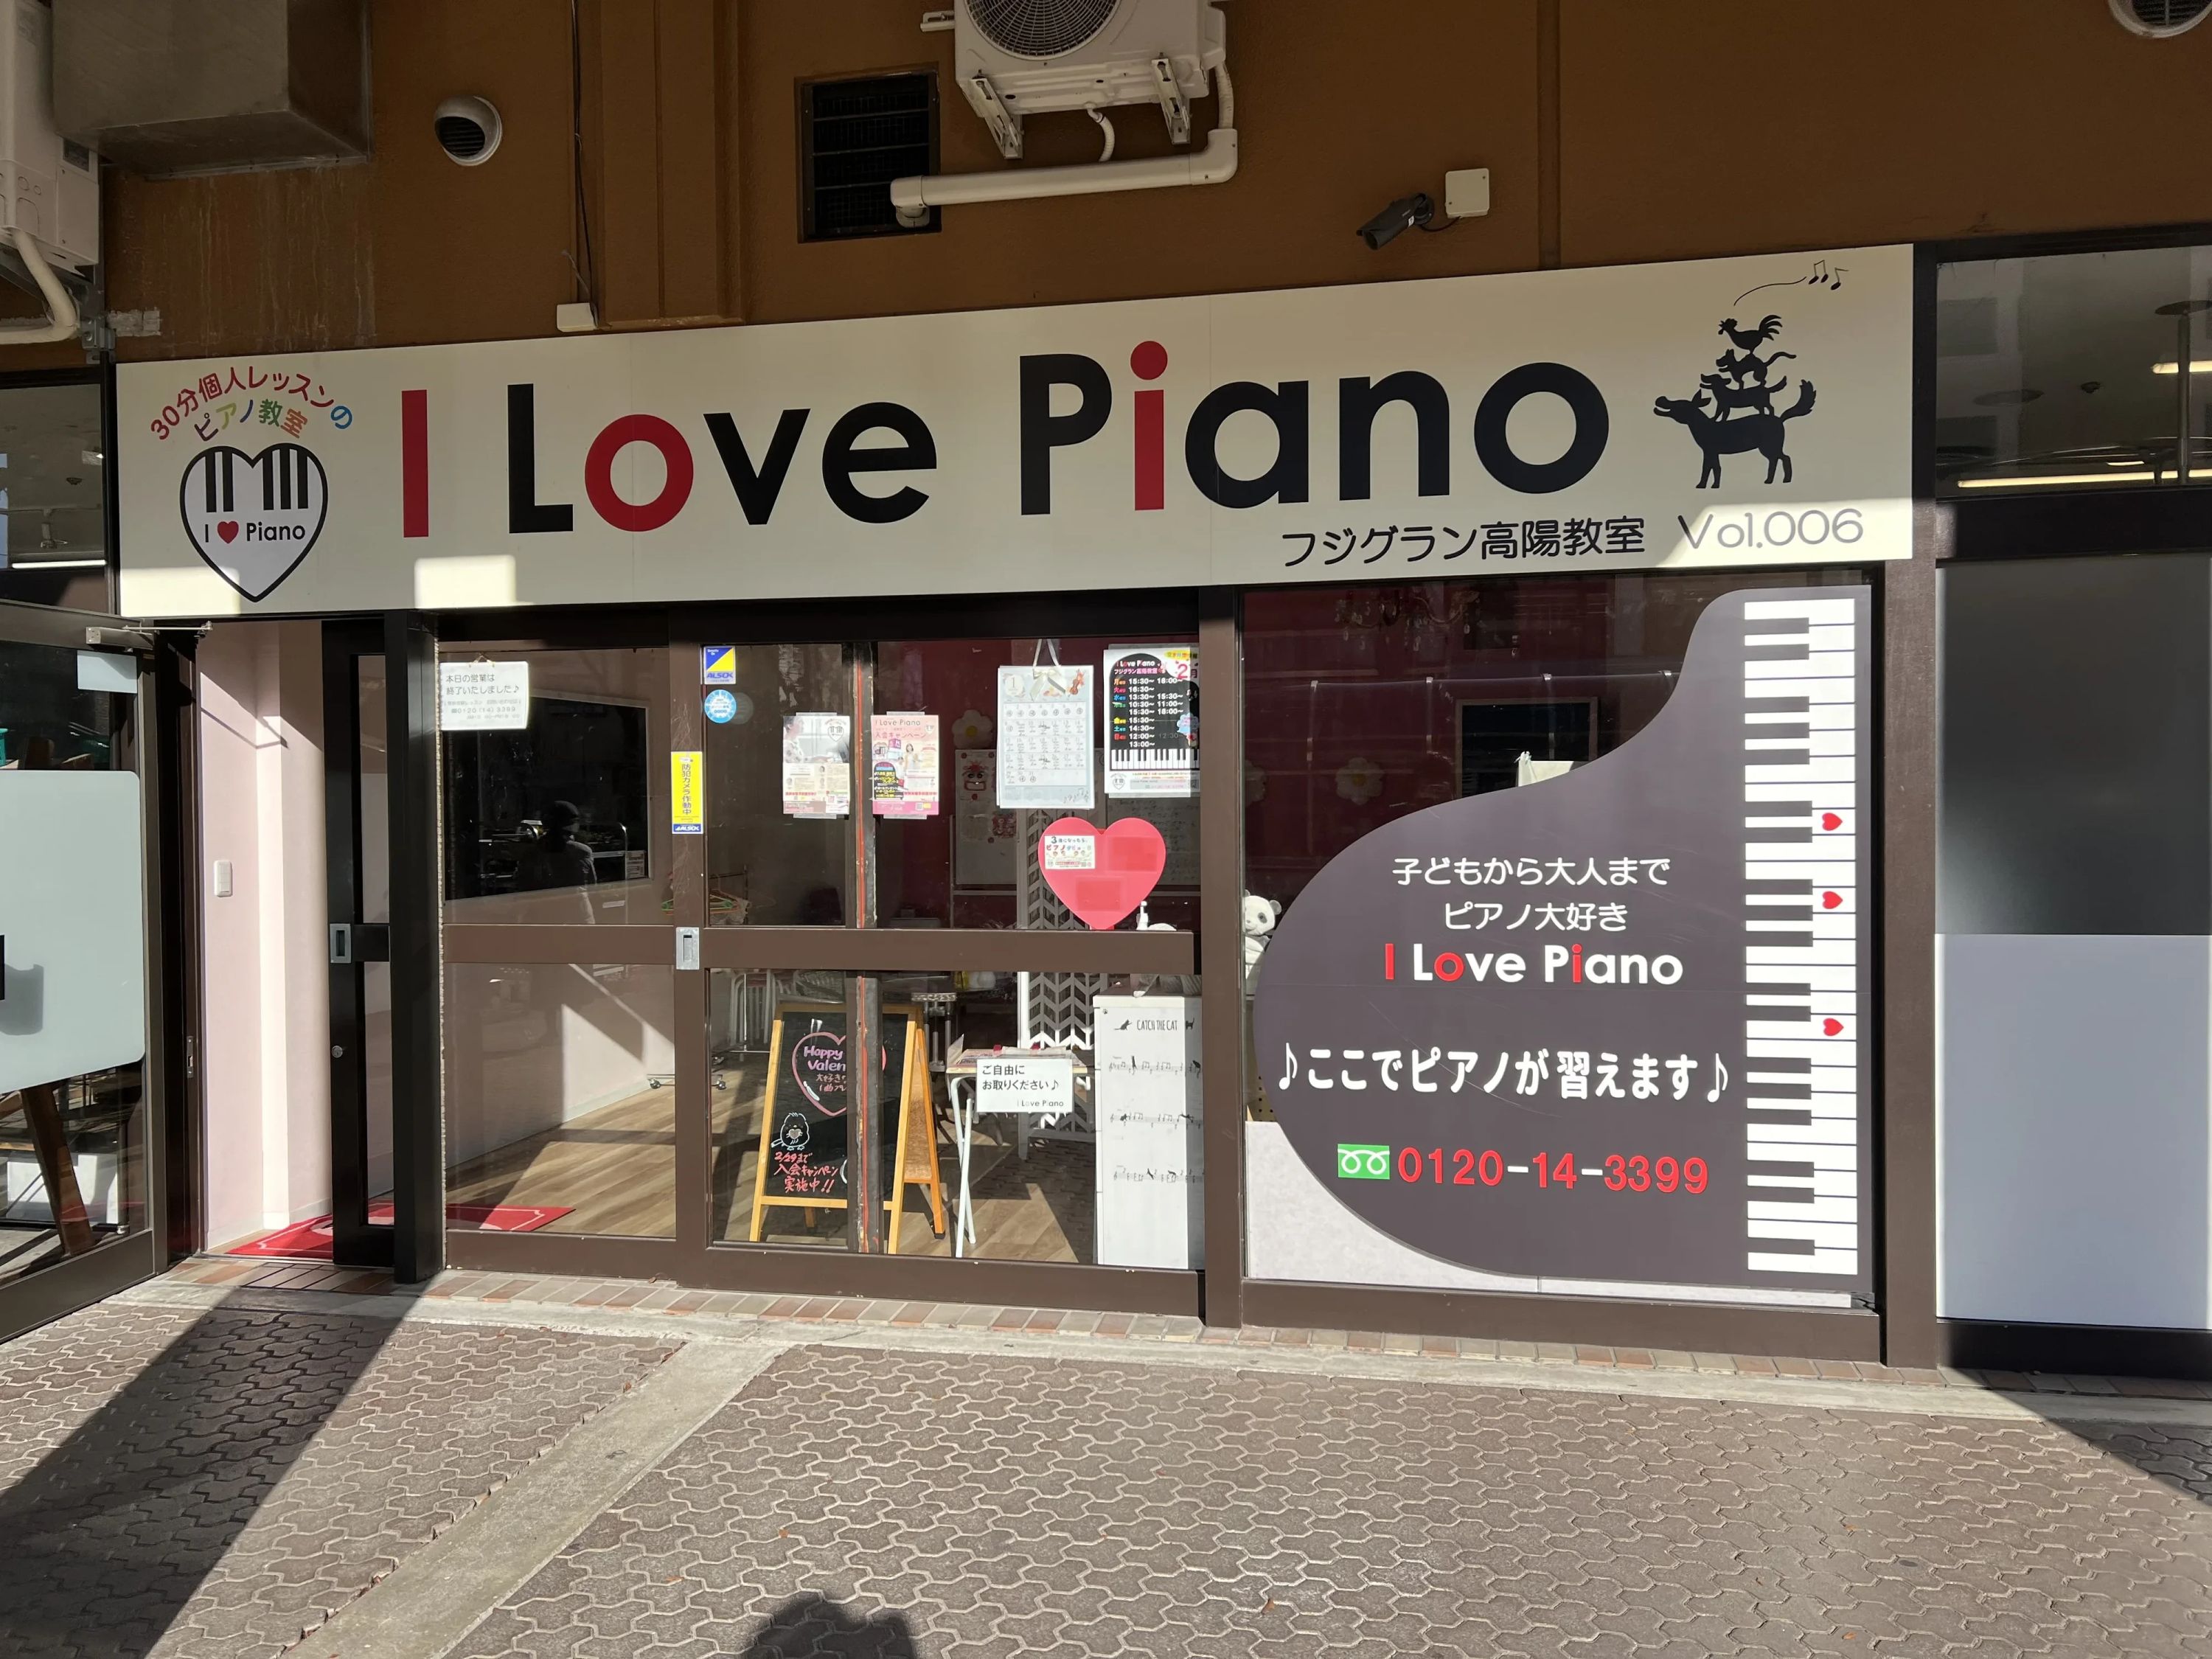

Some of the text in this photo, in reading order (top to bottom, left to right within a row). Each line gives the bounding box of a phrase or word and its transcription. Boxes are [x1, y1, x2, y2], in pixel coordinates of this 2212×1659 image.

[150, 366, 353, 440] 30分個人レッスンの
[194, 398, 309, 442] ピアノ教室
[401, 340, 1610, 538] I Love Piano
[204, 521, 306, 543] I Piano
[1281, 507, 1864, 568] フジグラン高陽教室 Vol.006
[445, 673, 495, 683] 本日の営業は
[446, 685, 512, 695] 終了いたしました
[682, 764, 692, 815] 防犯カメラ作動中
[1392, 857, 1670, 886] 子どもから大人まで
[1444, 901, 1628, 932] ピアノ大好き
[1385, 943, 1683, 985] I Love Piano
[1136, 1020, 1178, 1031] CATCH THE CAT
[804, 1046, 844, 1060] Happy
[982, 1065, 1026, 1076] ご自由に
[1308, 1046, 1699, 1100] ここでピアノが習えます
[774, 1151, 813, 1164] 2/29まで
[1397, 1147, 1709, 1194] 0120-14-3399
